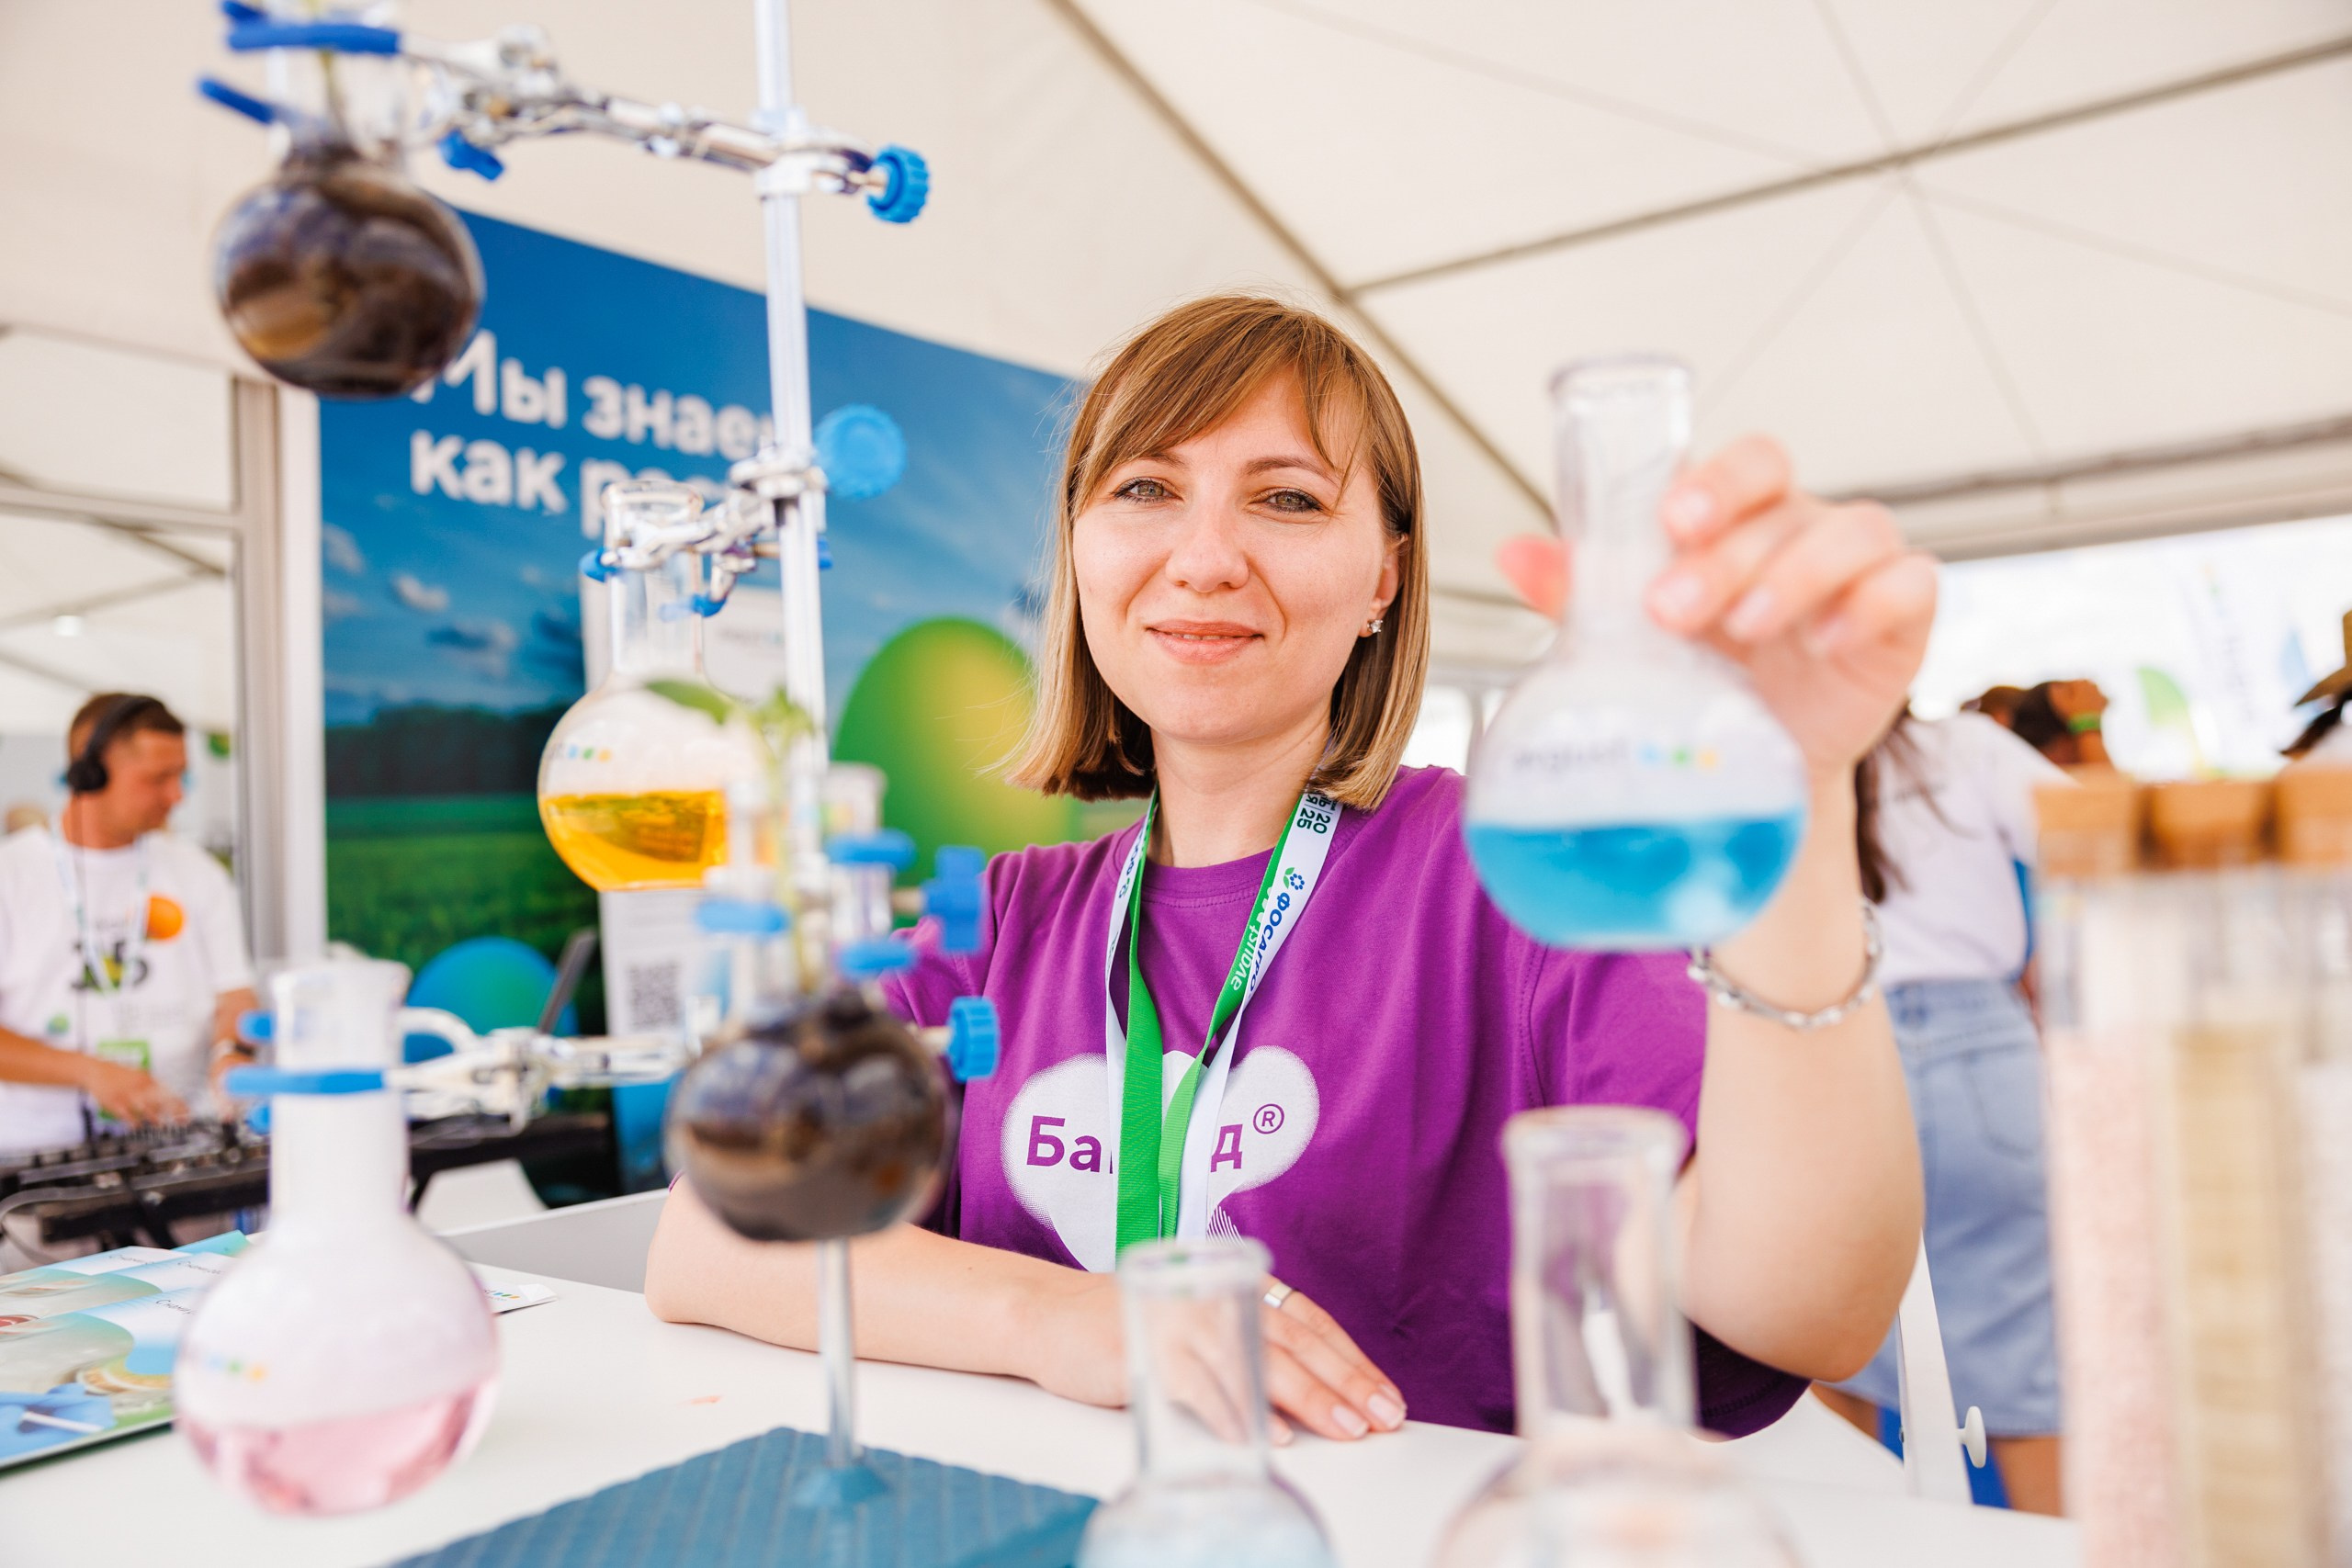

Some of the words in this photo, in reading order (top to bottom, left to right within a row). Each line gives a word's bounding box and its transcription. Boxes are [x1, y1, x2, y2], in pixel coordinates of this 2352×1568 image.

[410, 328, 568, 429] Мы
[581, 375, 775, 461] знае
[410, 429, 568, 514] как
[1296, 807, 1316, 829] 25
[1313, 813, 1331, 834] 20
[1250, 892, 1291, 992] ФОСАГРО
